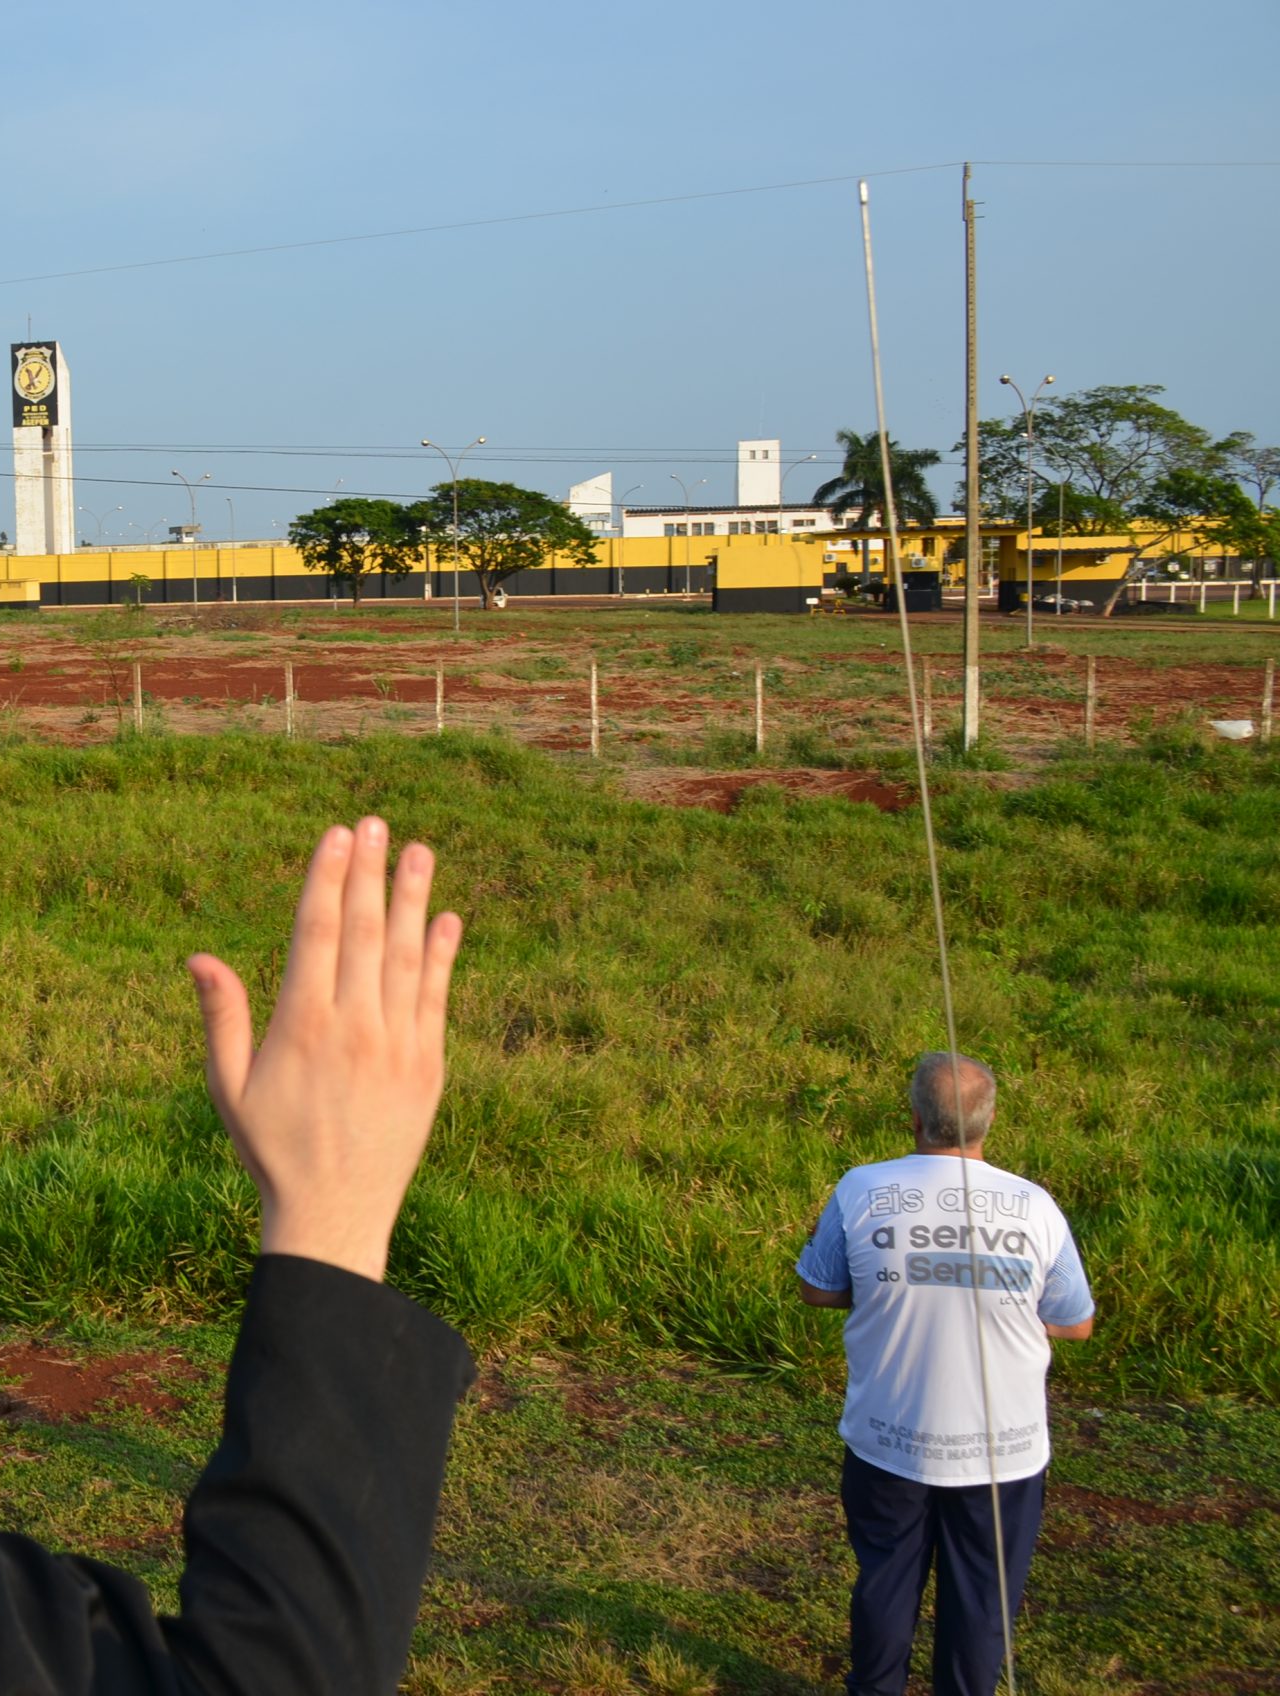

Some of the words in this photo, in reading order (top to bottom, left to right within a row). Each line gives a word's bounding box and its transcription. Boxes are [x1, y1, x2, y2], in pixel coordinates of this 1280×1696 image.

[868, 1184, 924, 1218] Eis
[936, 1187, 1030, 1223] aqui
[871, 1226, 896, 1249] a
[909, 1225, 1026, 1255] serva
[876, 1267, 901, 1282] do
[923, 1448, 943, 1460] DE
[946, 1447, 983, 1460] MAIO
